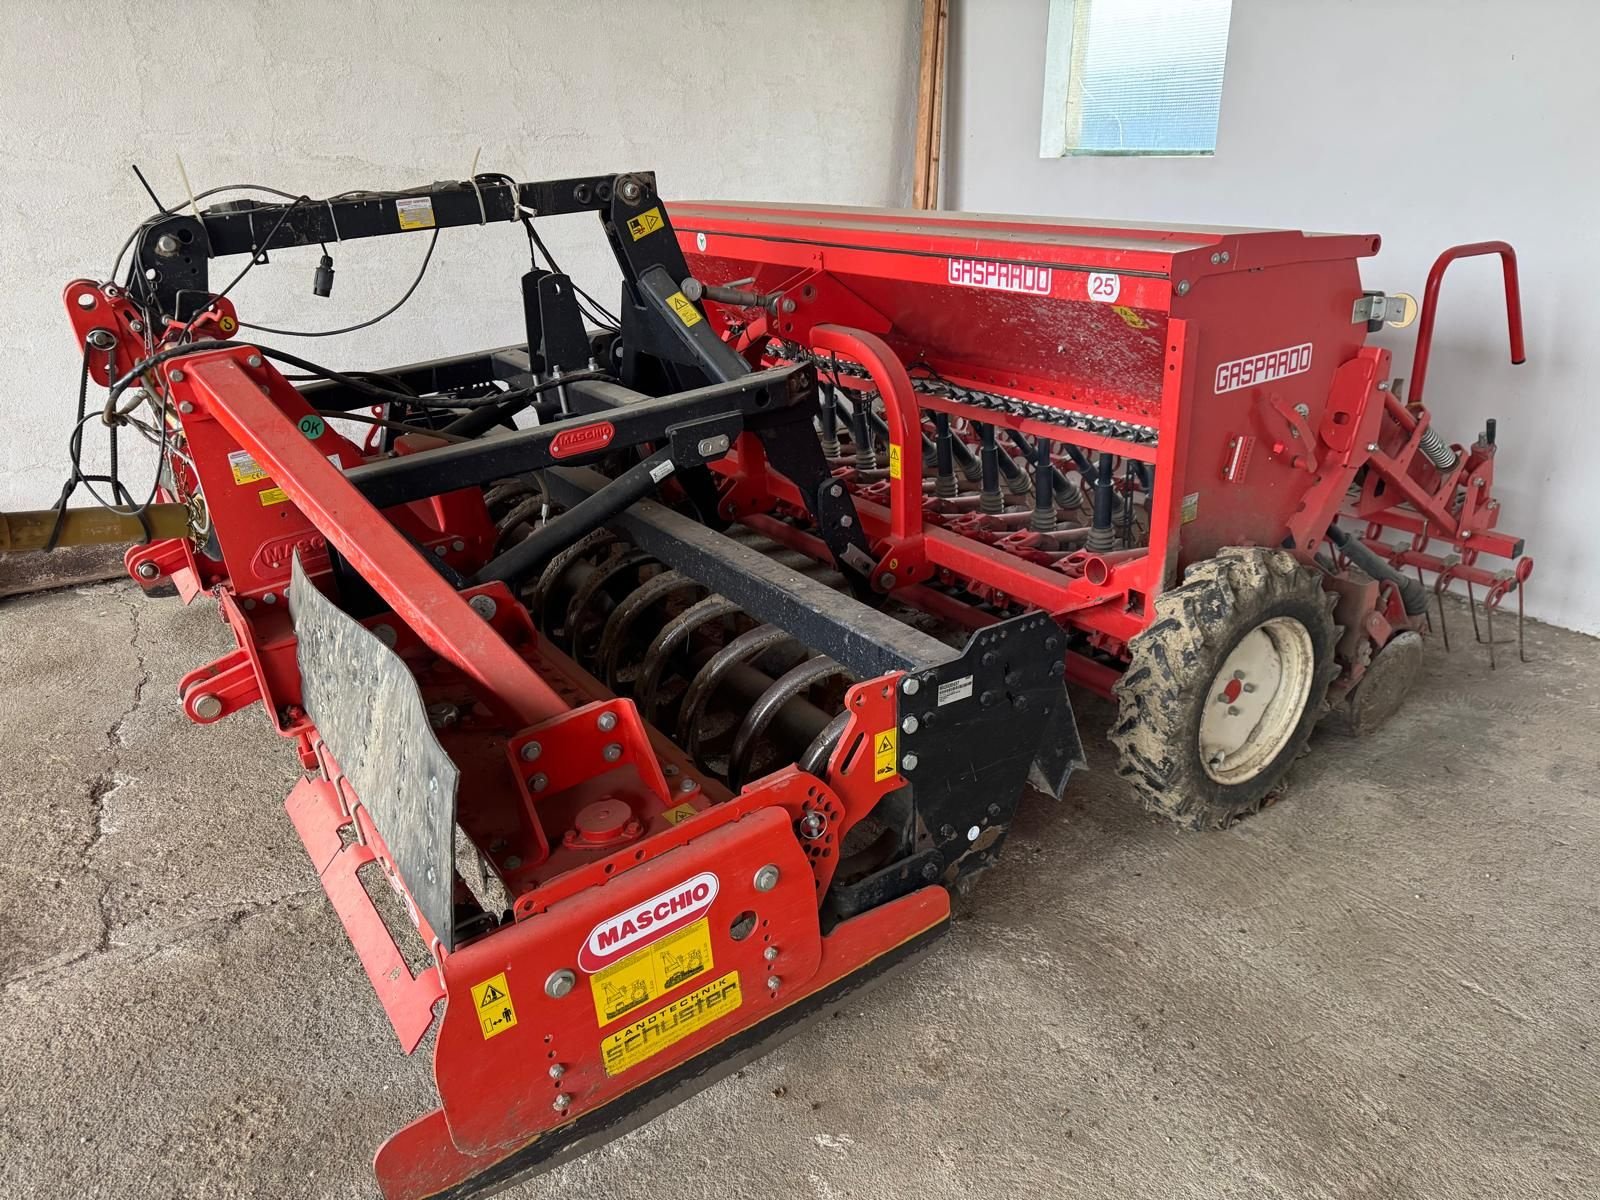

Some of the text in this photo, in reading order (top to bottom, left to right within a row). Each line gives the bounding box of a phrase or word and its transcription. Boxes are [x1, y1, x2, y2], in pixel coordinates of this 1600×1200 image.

[950, 258, 1051, 292] GASPARDO
[1092, 276, 1115, 296] 25
[1216, 345, 1311, 392] GASPARDO
[301, 419, 320, 435] OK
[597, 883, 710, 950] MASCHIO
[614, 977, 727, 1043] LANDTECHNIK
